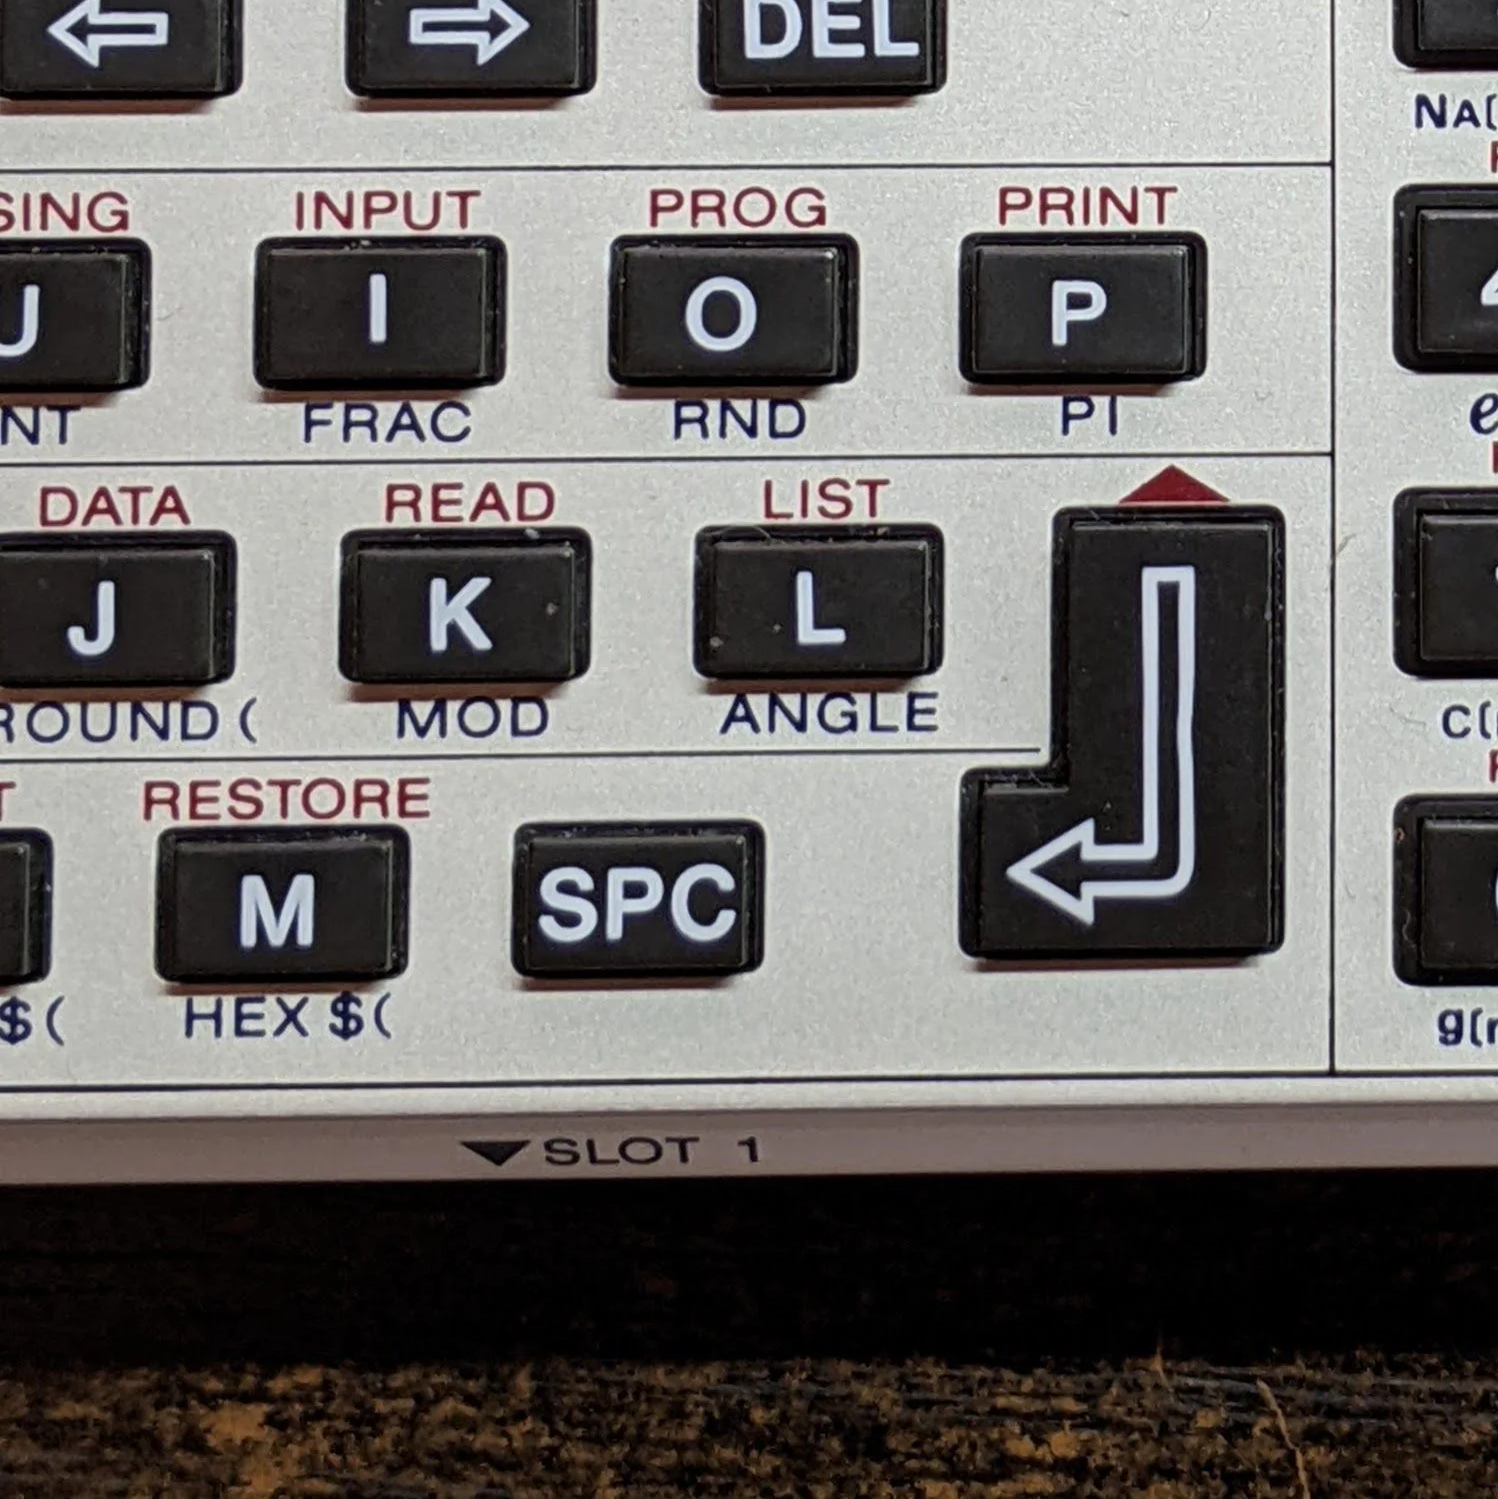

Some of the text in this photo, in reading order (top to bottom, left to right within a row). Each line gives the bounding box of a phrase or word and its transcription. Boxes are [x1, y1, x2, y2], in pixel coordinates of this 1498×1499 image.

[295, 190, 481, 231] INPUT
[649, 187, 827, 228] PROG
[999, 186, 1178, 226] PRINT
[369, 273, 387, 344] I
[685, 276, 757, 351] O
[1051, 280, 1107, 346] P
[304, 403, 471, 443] FRAC
[673, 399, 807, 439] RND
[1062, 397, 1118, 436] PI
[39, 485, 191, 526] DATA
[386, 482, 556, 523] READ
[763, 479, 891, 520] LIST
[67, 581, 115, 657] J
[429, 577, 493, 652] K
[796, 570, 846, 645] L
[397, 698, 550, 739] MOD
[719, 692, 939, 734] ANGLE
[142, 778, 431, 822] RESTORE
[241, 874, 314, 948] M
[538, 864, 737, 943] SPC
[544, 1138, 759, 1166] SLOT 1
